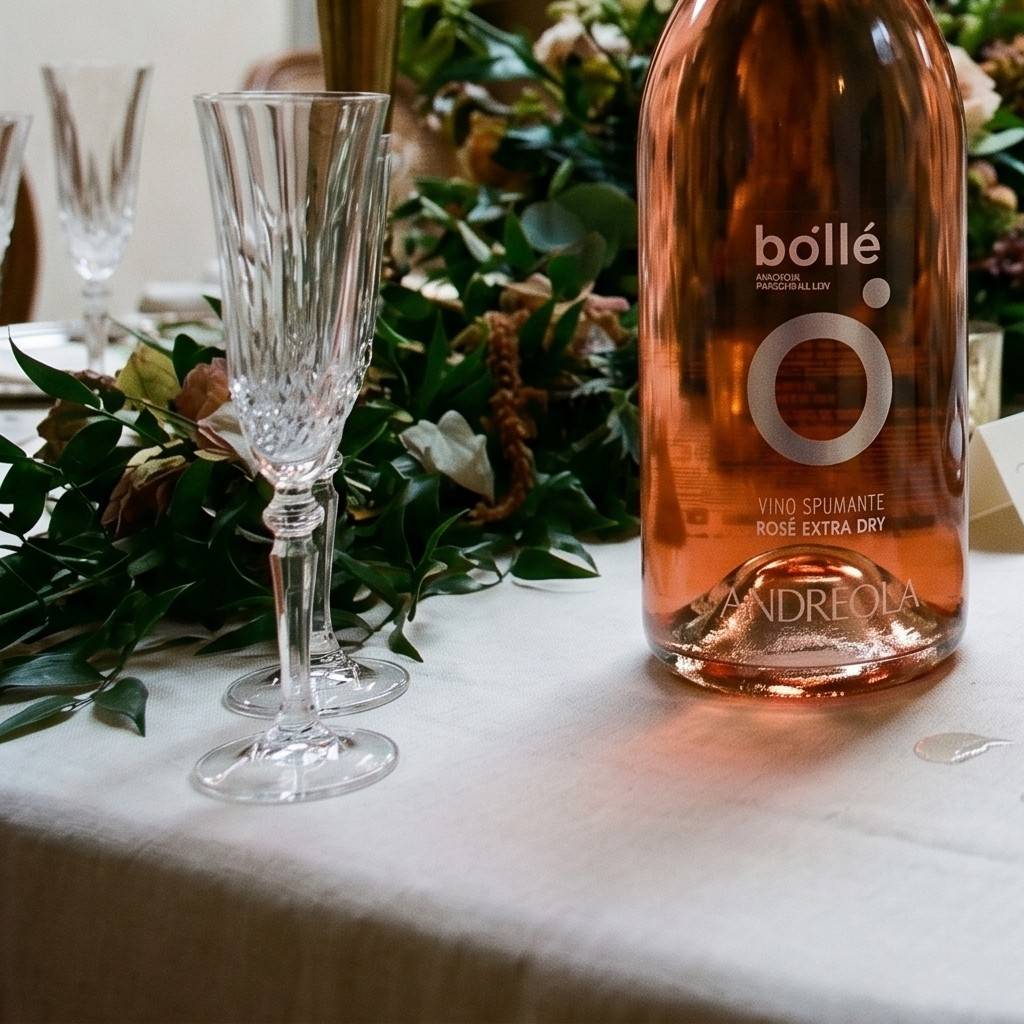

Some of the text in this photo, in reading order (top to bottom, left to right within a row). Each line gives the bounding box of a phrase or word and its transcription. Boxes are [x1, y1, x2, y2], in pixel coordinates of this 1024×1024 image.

[758, 493, 885, 515] VINO SPUMANTE
[756, 516, 886, 536] ROSÉ EXTRA DRY
[720, 578, 921, 624] ANDREOLA
